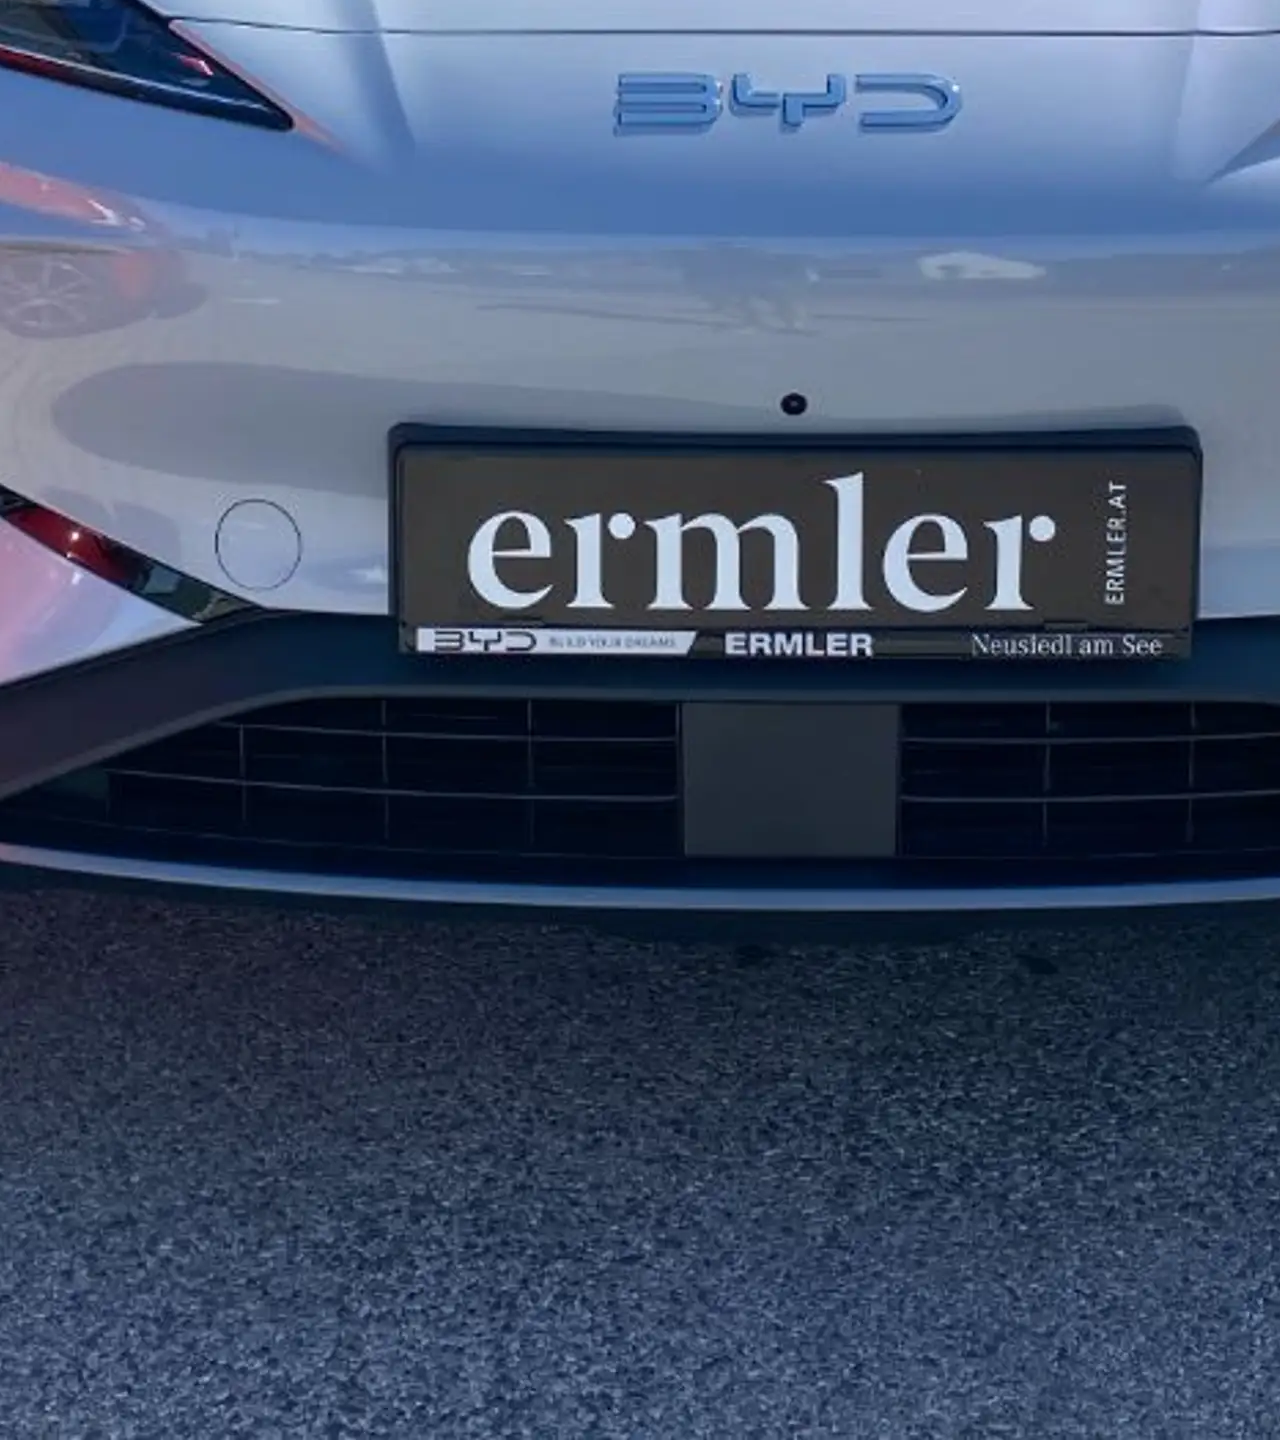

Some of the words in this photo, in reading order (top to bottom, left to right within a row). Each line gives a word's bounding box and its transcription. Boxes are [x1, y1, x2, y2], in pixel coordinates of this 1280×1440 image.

[617, 73, 963, 129] BYD
[466, 470, 1057, 612] ermler
[1105, 479, 1128, 605] ERMLER.AT
[434, 630, 538, 652] BYD
[723, 632, 874, 657] ERMLER
[970, 633, 1072, 657] Neusiedl
[1078, 638, 1114, 656] am
[1122, 634, 1164, 656] See
